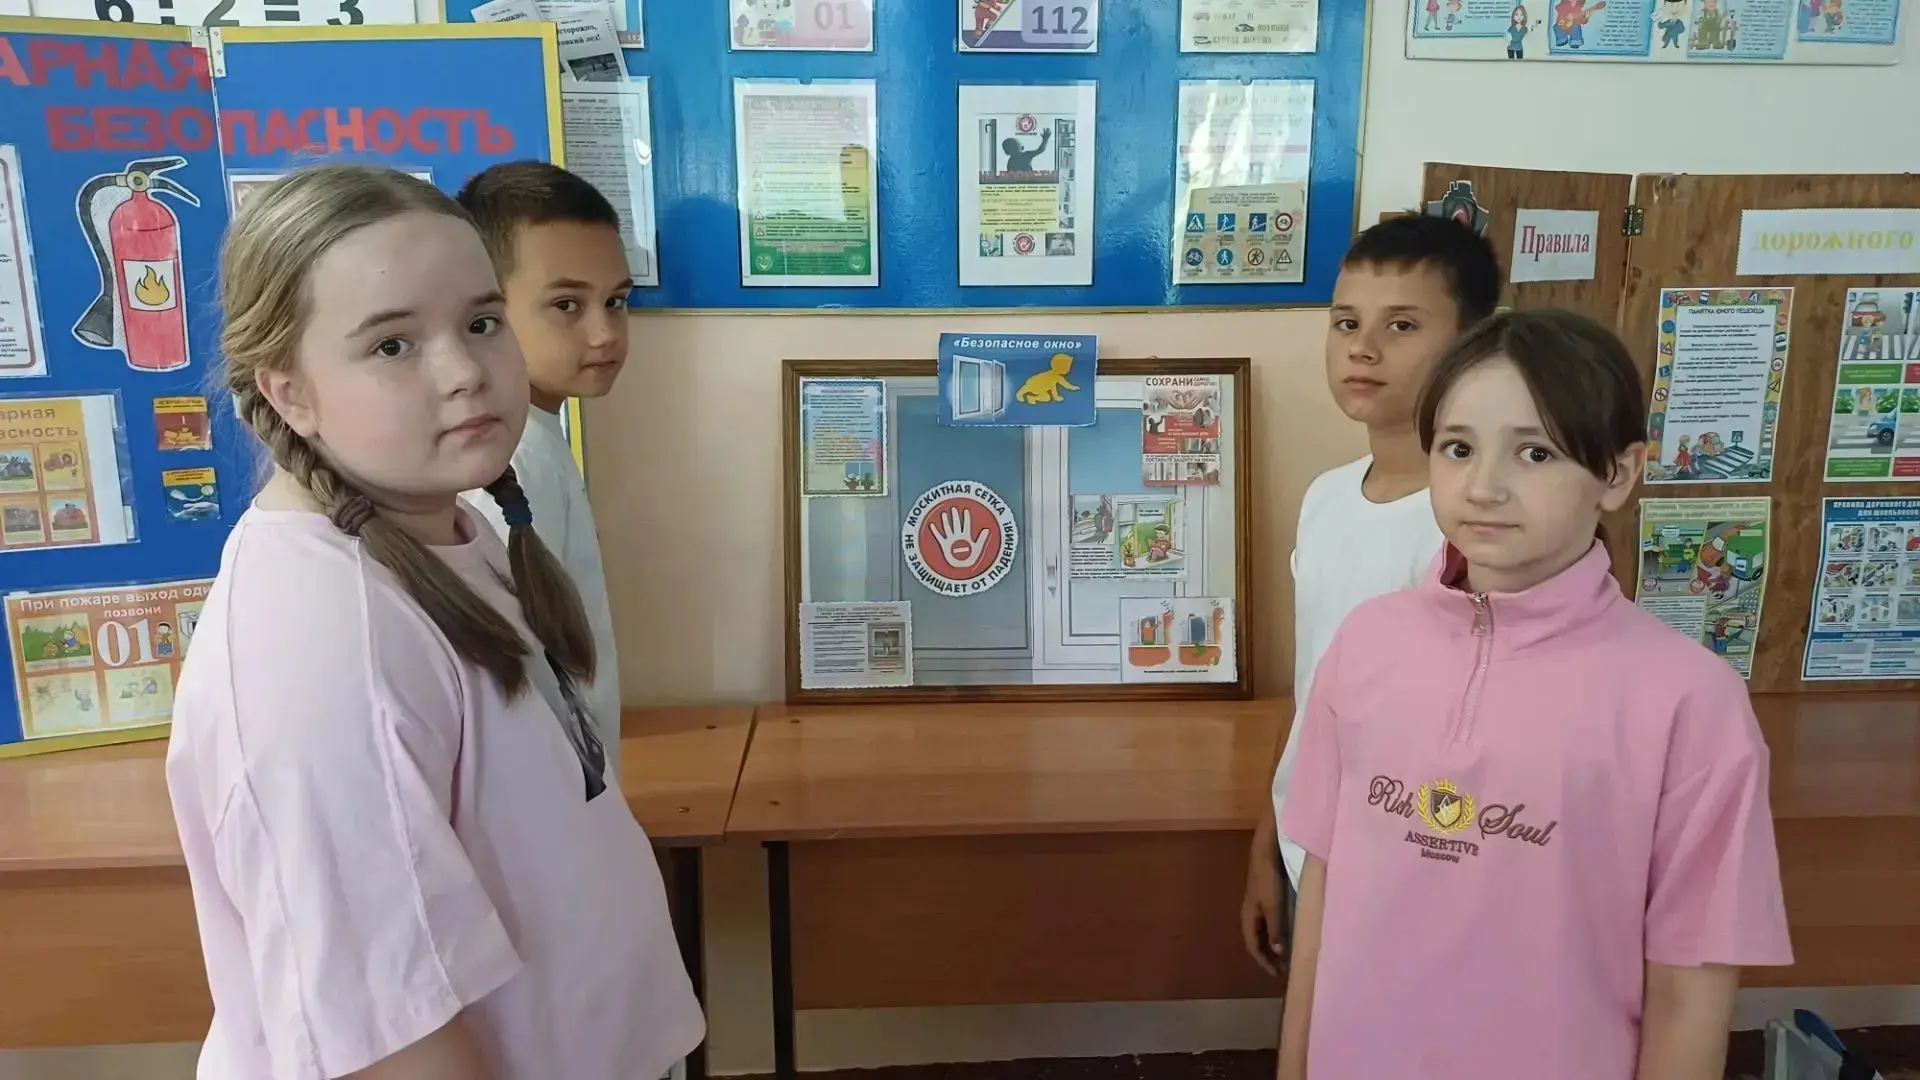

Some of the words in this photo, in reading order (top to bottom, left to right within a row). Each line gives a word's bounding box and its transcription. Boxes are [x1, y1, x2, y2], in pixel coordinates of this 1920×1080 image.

[815, 2, 853, 29] 01
[1031, 6, 1089, 34] 112
[558, 25, 597, 35] сторожно,
[0, 37, 212, 93] АРНАЯ
[45, 105, 516, 156] БЕЗОПАСНОСТЬ
[1520, 225, 1590, 262] Правила
[1751, 230, 1915, 258] дорожного
[953, 336, 1044, 350] «Безопасное
[1044, 340, 1082, 350] окно»
[1145, 377, 1193, 387] СОХРАНИ
[0, 408, 56, 423] арная
[0, 426, 78, 439] асность
[907, 484, 972, 527] МОСКИТНАЯ
[974, 487, 1006, 516] СЕТКА
[905, 534, 915, 550] НЕ
[988, 521, 1014, 581] ПАДЕНИЯ!
[908, 553, 968, 593] ЗАЩИЩАЕТ
[971, 578, 988, 591] ОТ
[20, 598, 55, 612] При
[60, 593, 120, 608] пожаре
[126, 588, 179, 602] выход
[183, 586, 211, 598] оди
[104, 605, 162, 619] позвони
[96, 618, 160, 667] 01
[1478, 804, 1558, 847] Soul
[1404, 830, 1480, 857] ASSERTIVE
[1421, 848, 1460, 863] Moscow
